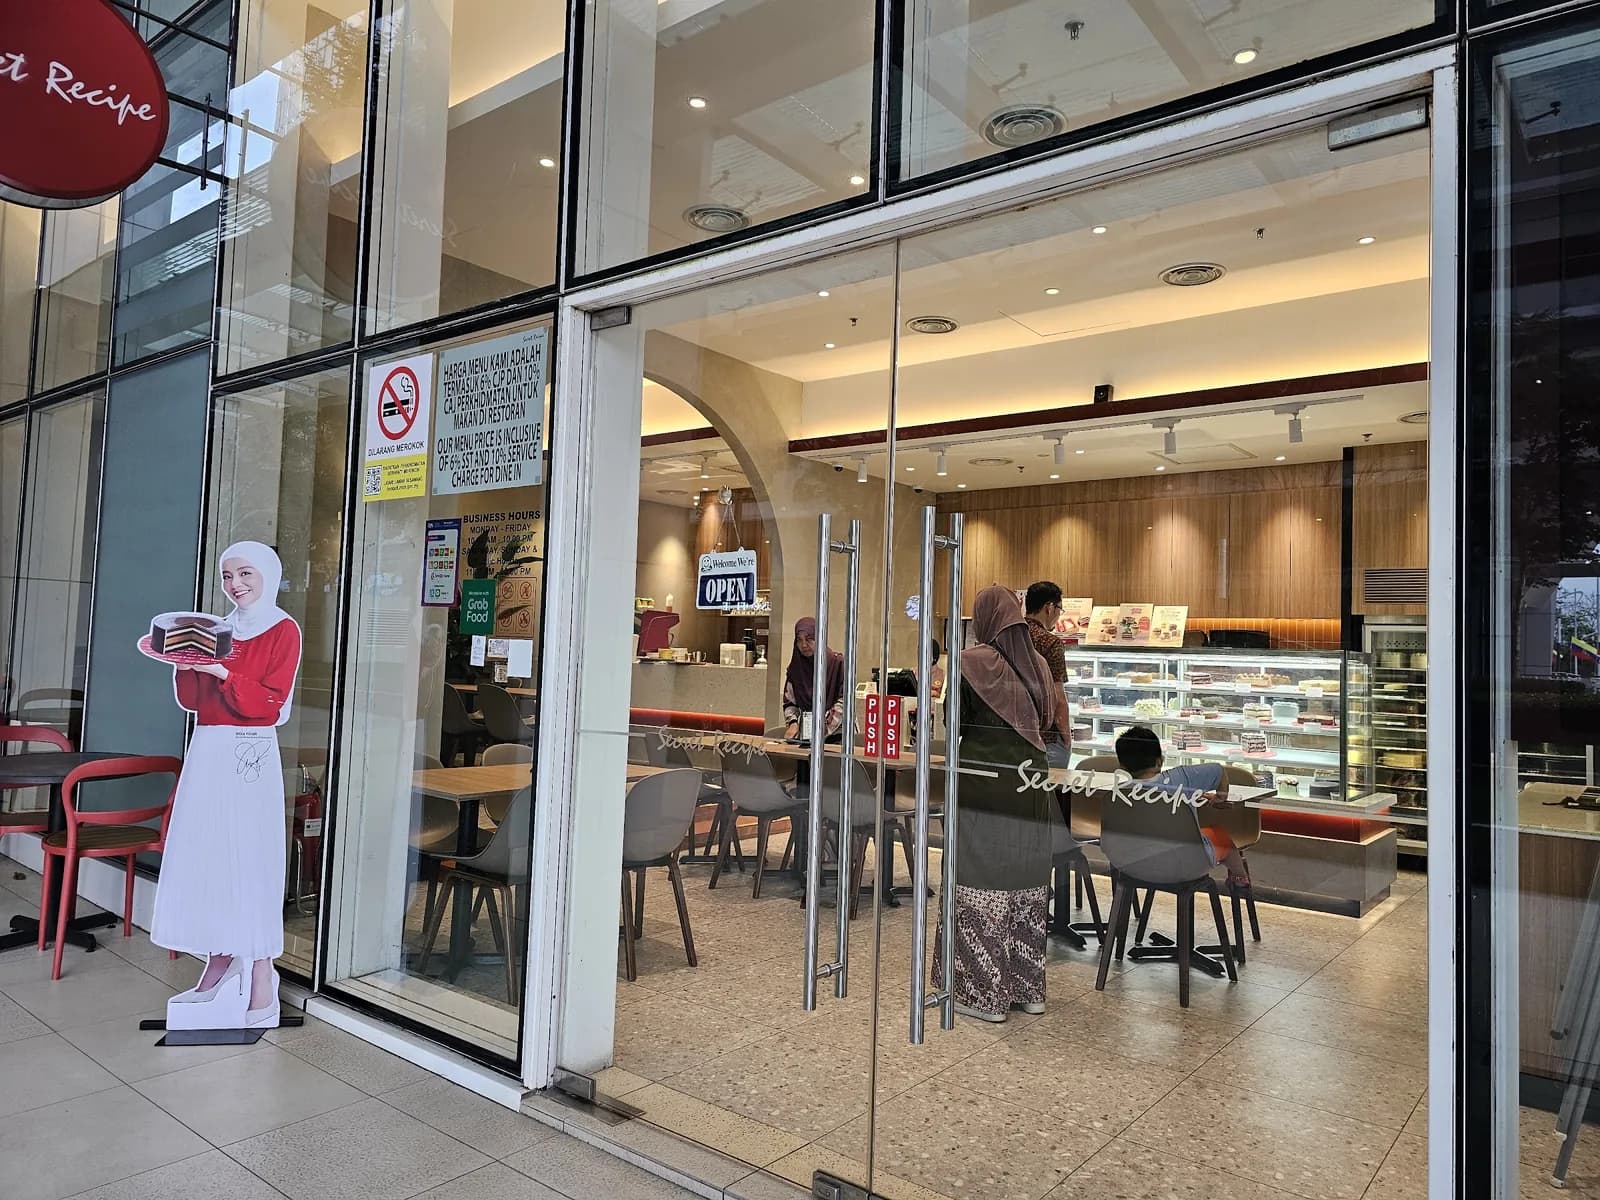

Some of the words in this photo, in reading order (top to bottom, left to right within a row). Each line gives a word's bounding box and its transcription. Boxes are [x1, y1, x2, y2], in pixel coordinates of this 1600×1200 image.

[46, 61, 156, 126] Recipe
[443, 361, 467, 381] HARGA
[468, 356, 489, 376] MENU
[490, 351, 509, 371] KAMI
[510, 344, 542, 369] ADALAH
[443, 374, 480, 398] TERMASUK
[480, 374, 492, 391] 6%
[492, 369, 506, 388] CJP
[506, 366, 523, 386] DAN
[524, 363, 540, 381] 10%
[443, 397, 456, 415] CAJ
[457, 386, 511, 412] PERKHIDMATAN
[512, 380, 539, 402] UNTUK
[453, 409, 478, 431] MAKAN
[479, 408, 487, 426] DI
[488, 401, 526, 425] RESTORAN
[368, 445, 395, 457] DILARANG
[396, 441, 424, 452] MEROKOK
[437, 437, 453, 455] OUR
[454, 433, 474, 452] MENU
[474, 430, 495, 449] PRICE
[495, 429, 502, 447] IS
[503, 422, 541, 445] INCLUSIVE
[438, 455, 449, 472] OF
[449, 454, 461, 471] 6%
[461, 451, 474, 470] SST
[475, 449, 490, 467] AND
[491, 447, 506, 465] 10%
[507, 442, 537, 463] SERVICE
[451, 469, 479, 488] CHARGE
[480, 466, 494, 484] FOR
[495, 464, 512, 483] DINE
[513, 463, 522, 481] IN
[463, 512, 506, 523] BUSINESS
[508, 510, 541, 520] HOURS
[470, 525, 499, 534] MONDAY
[505, 523, 531, 532] FRIDAY
[712, 559, 737, 569] Welcome
[467, 598, 489, 611] Grab
[705, 577, 748, 604] OPEN
[466, 611, 489, 623] Food
[867, 698, 877, 754] PUSH
[887, 699, 896, 756] PUSH
[657, 725, 704, 752] Secret
[712, 729, 768, 765] Recipe
[1016, 759, 1099, 798] Secret
[1111, 768, 1209, 815] Recipe
